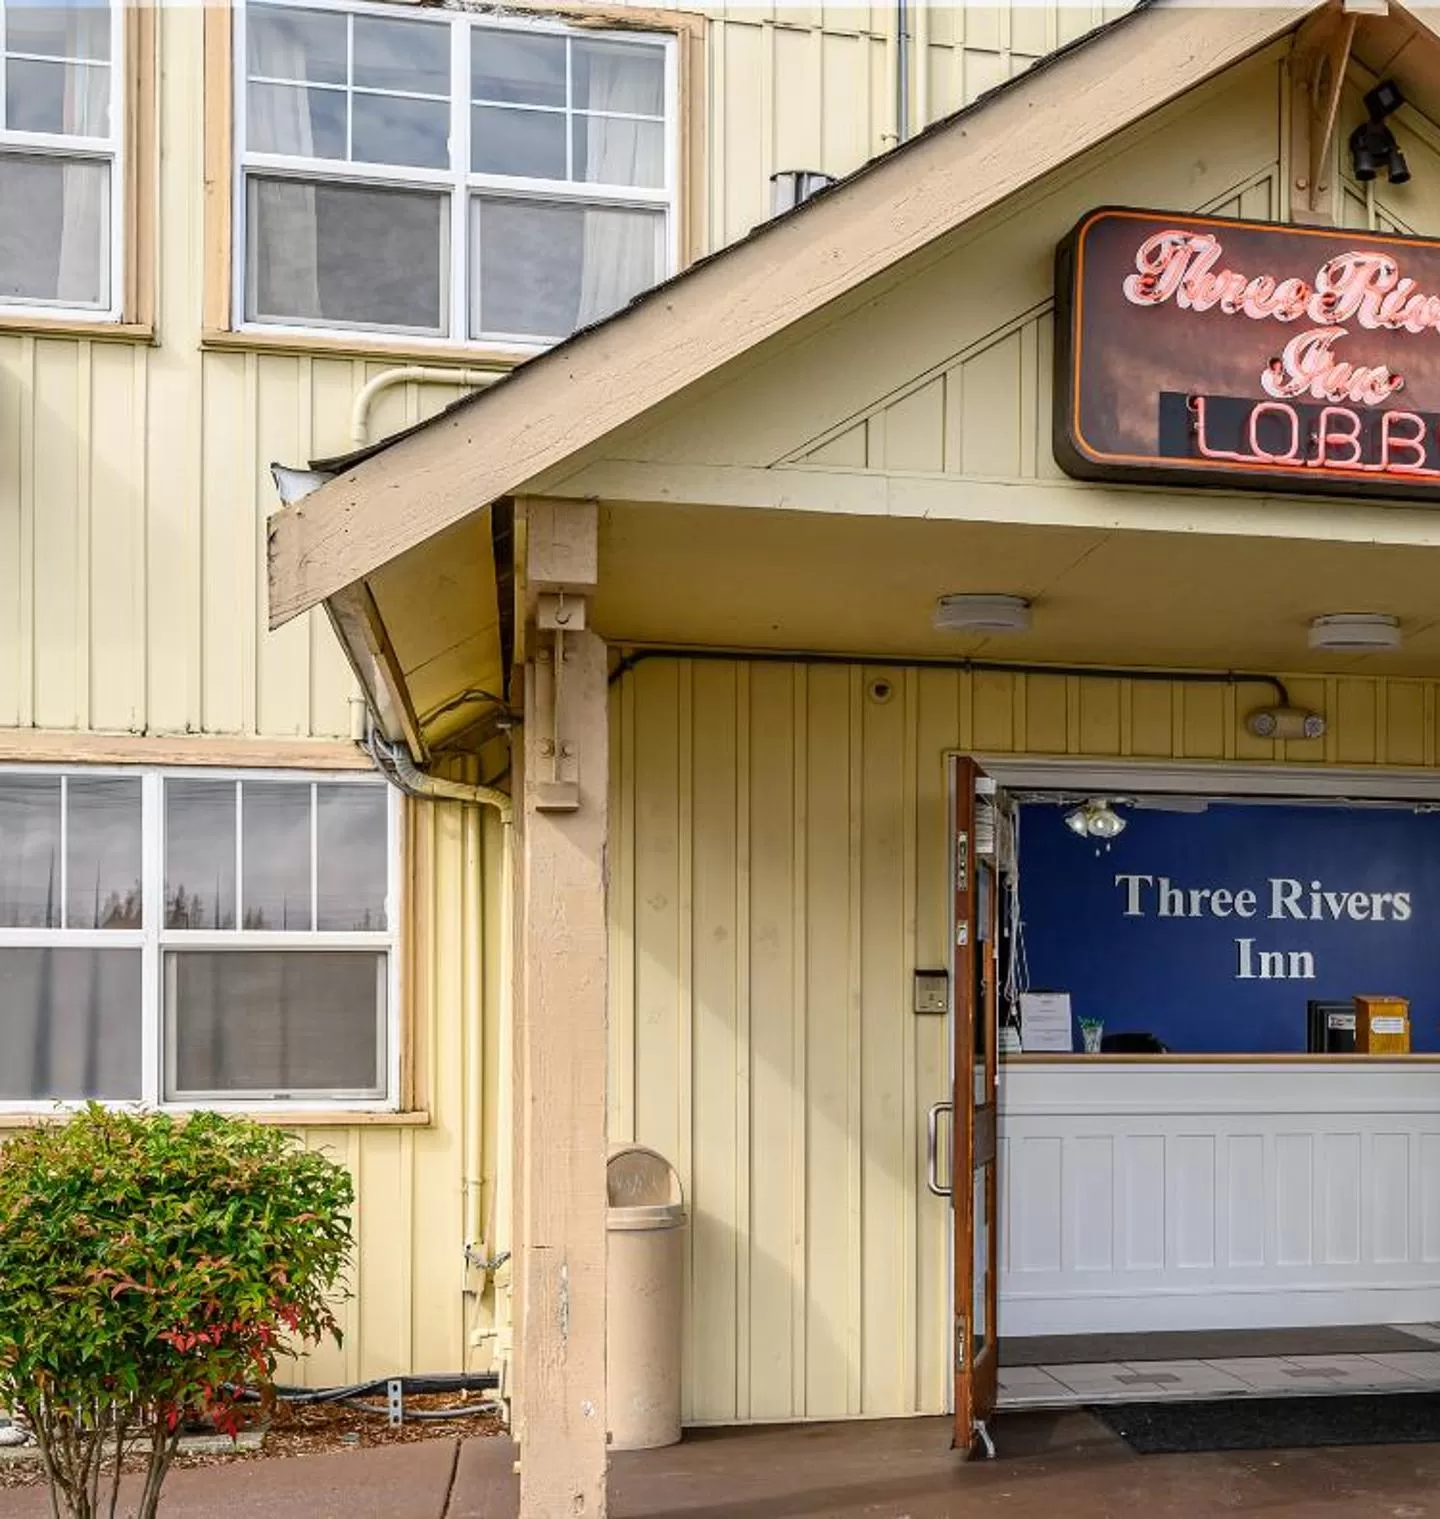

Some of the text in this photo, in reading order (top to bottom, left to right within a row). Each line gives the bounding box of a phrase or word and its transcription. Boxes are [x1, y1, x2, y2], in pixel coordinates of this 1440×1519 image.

[1122, 229, 1308, 323] Three
[1260, 325, 1405, 405] Inn
[1115, 874, 1412, 921] Three Rivers
[1234, 937, 1316, 980] Inn
